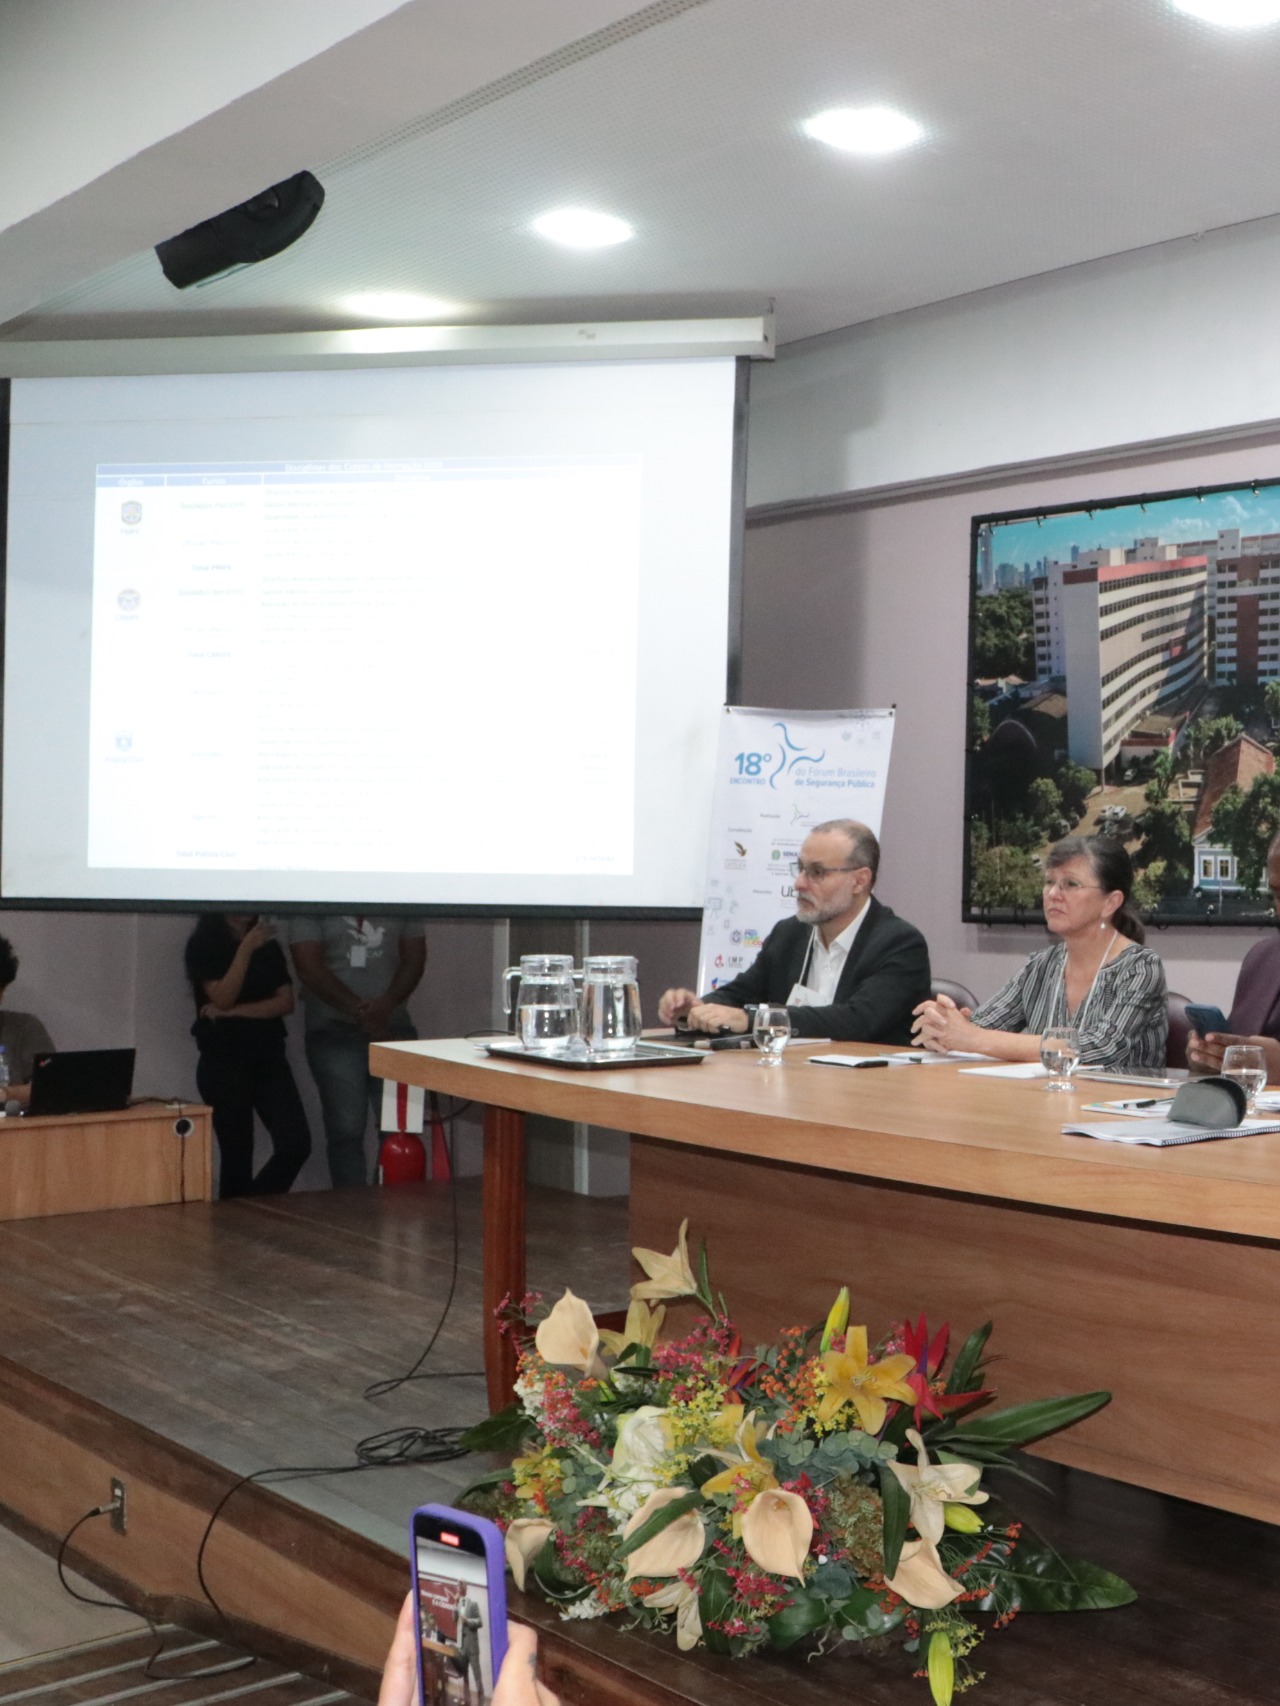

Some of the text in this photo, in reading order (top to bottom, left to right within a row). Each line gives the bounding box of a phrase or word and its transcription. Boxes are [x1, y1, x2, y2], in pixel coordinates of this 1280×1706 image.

[795, 765, 877, 778] do Fórum Brasileiro
[730, 777, 766, 786] ENCONTRO
[795, 778, 875, 788] de Segurança Pública
